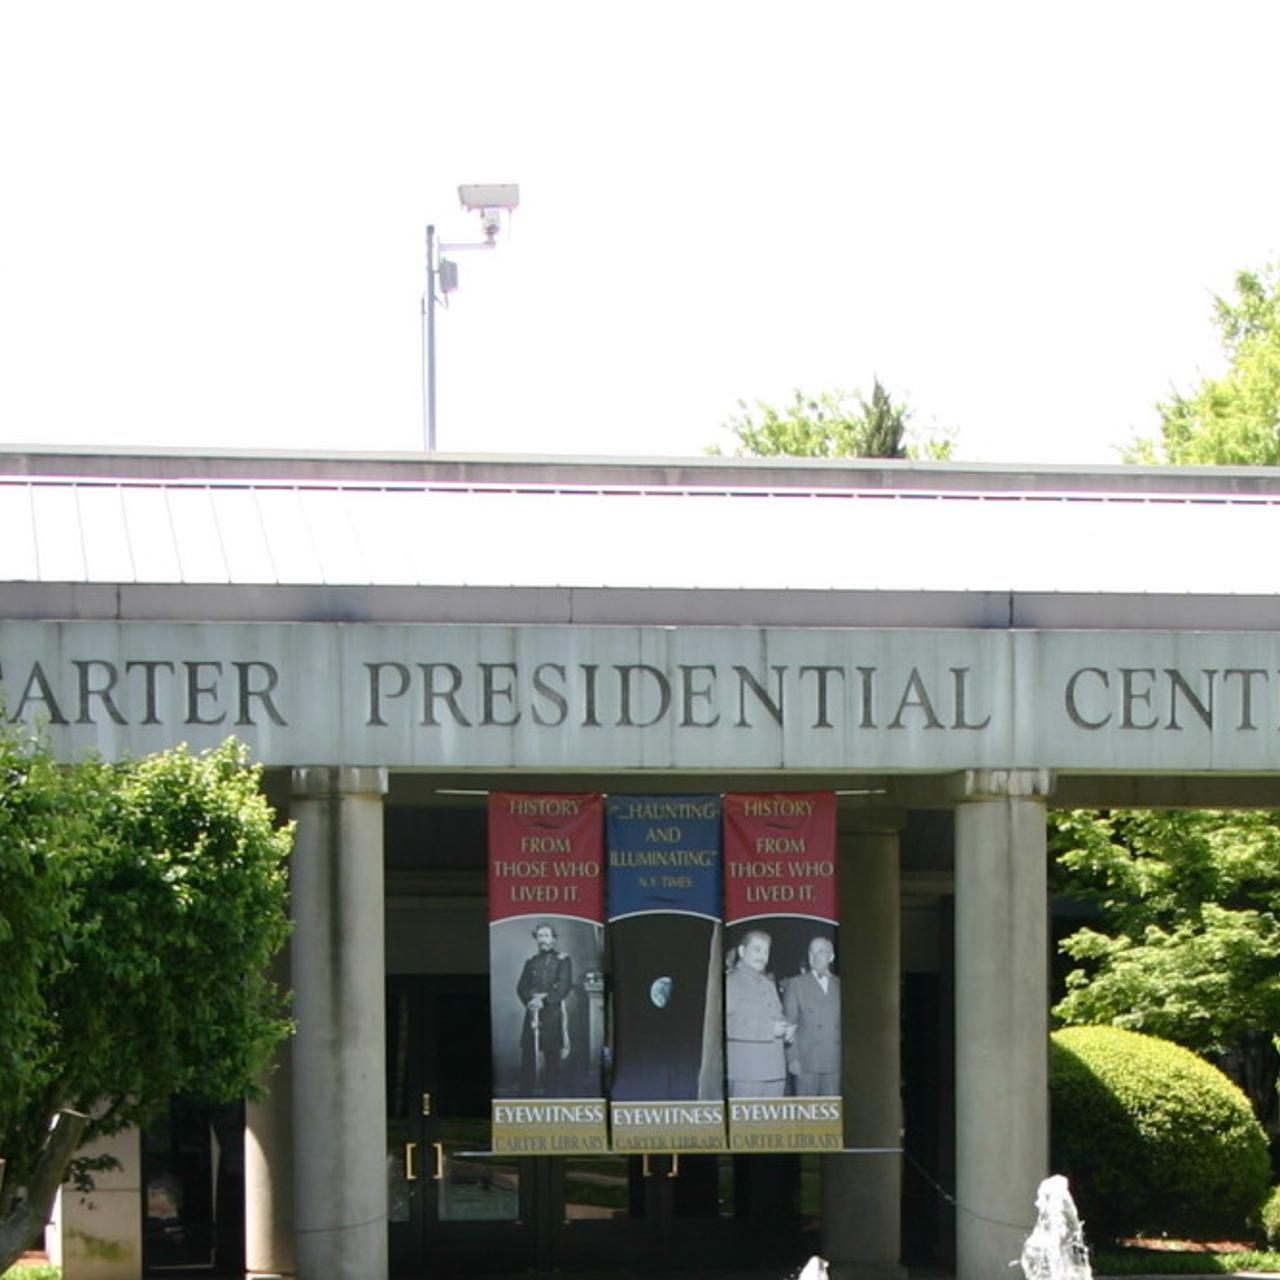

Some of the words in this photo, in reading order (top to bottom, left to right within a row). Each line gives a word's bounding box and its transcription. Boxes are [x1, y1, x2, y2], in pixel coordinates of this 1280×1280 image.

[364, 661, 992, 731] PRESIDENTIAL
[510, 799, 580, 816] HISTORY
[744, 800, 814, 817] HISTORY
[645, 827, 682, 843] AND
[521, 836, 571, 854] FROM
[756, 837, 806, 854] FROM
[495, 861, 548, 877] THOSE
[553, 861, 600, 878] WHO
[729, 861, 783, 878] THOSE
[788, 861, 835, 878] WHO
[511, 886, 559, 902] LIVED
[746, 886, 794, 903] LIVED
[495, 1105, 605, 1123] EYEWITNESS
[614, 1108, 723, 1125] EYEWITNESS
[732, 1103, 840, 1121] EYEWITNESS
[495, 1136, 548, 1152] CARTER
[550, 1136, 604, 1151] LIBRARY
[615, 1136, 667, 1151] CARTER
[670, 1136, 723, 1150] LIBRARY
[733, 1134, 784, 1150] CARTER
[787, 1134, 841, 1149] LIBRARY
